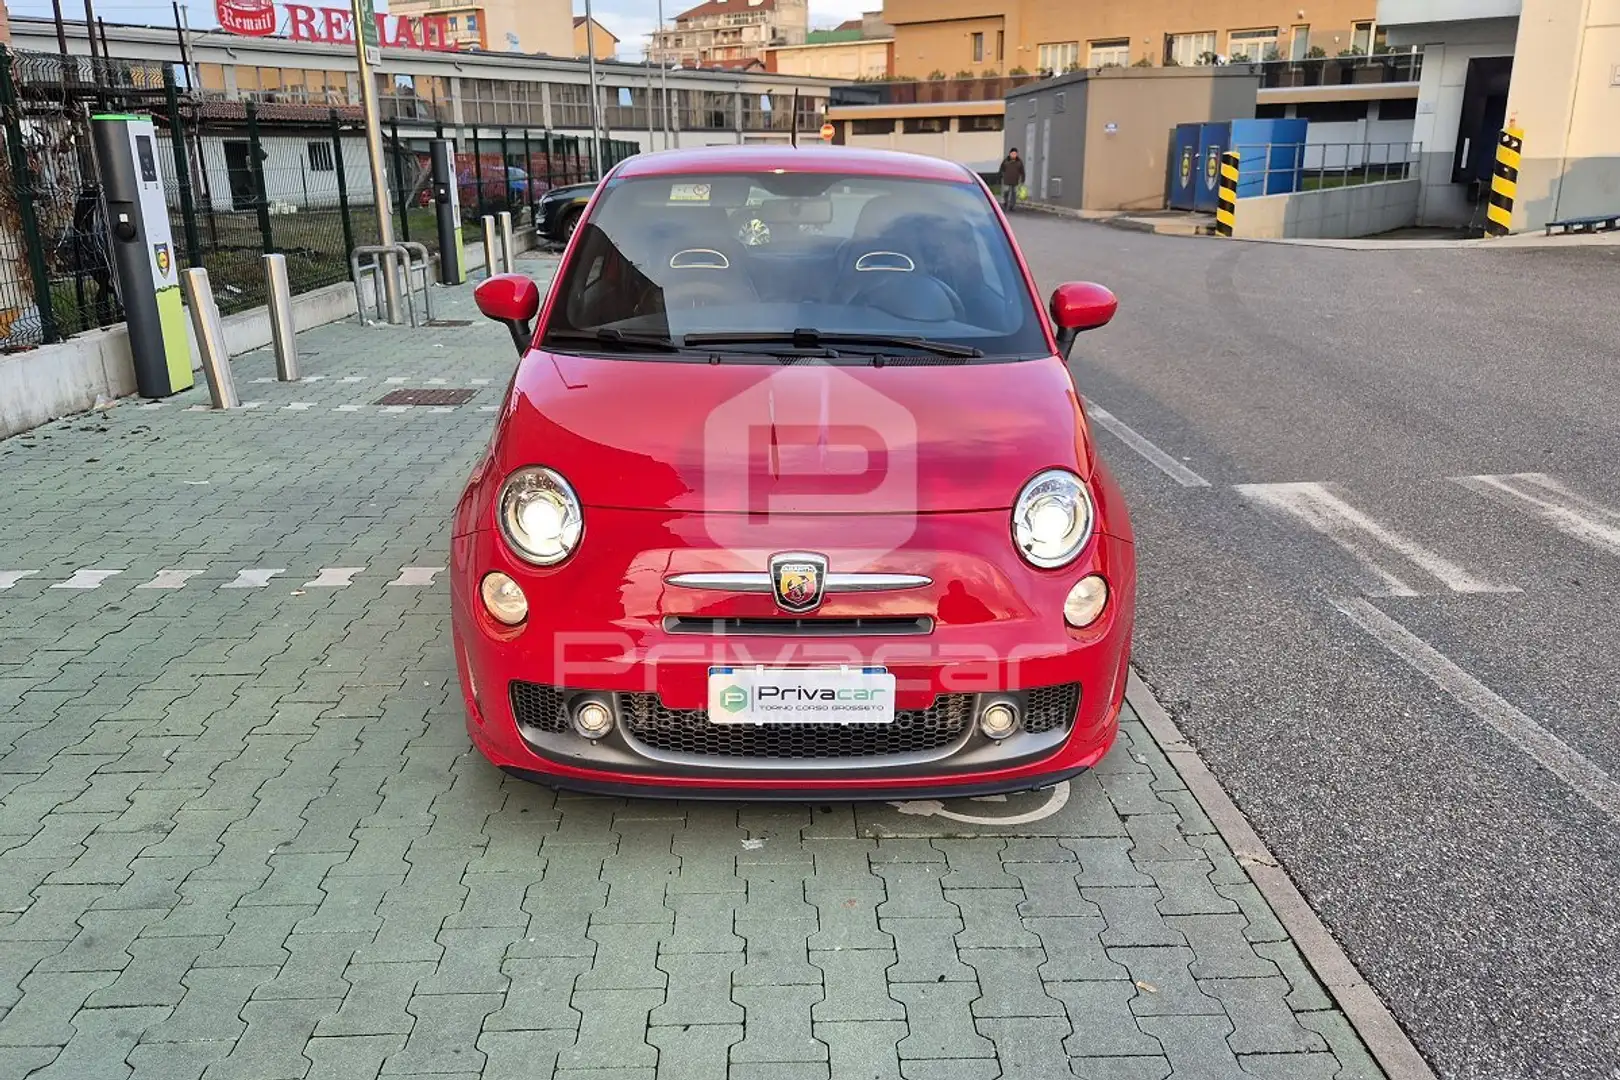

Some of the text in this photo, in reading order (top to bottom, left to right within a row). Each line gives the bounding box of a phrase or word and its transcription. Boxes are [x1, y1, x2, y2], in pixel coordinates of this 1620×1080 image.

[219, 5, 272, 31] Remail
[758, 685, 886, 701] Privacar
[759, 704, 885, 712] TORINO CORSO GROSSETO
